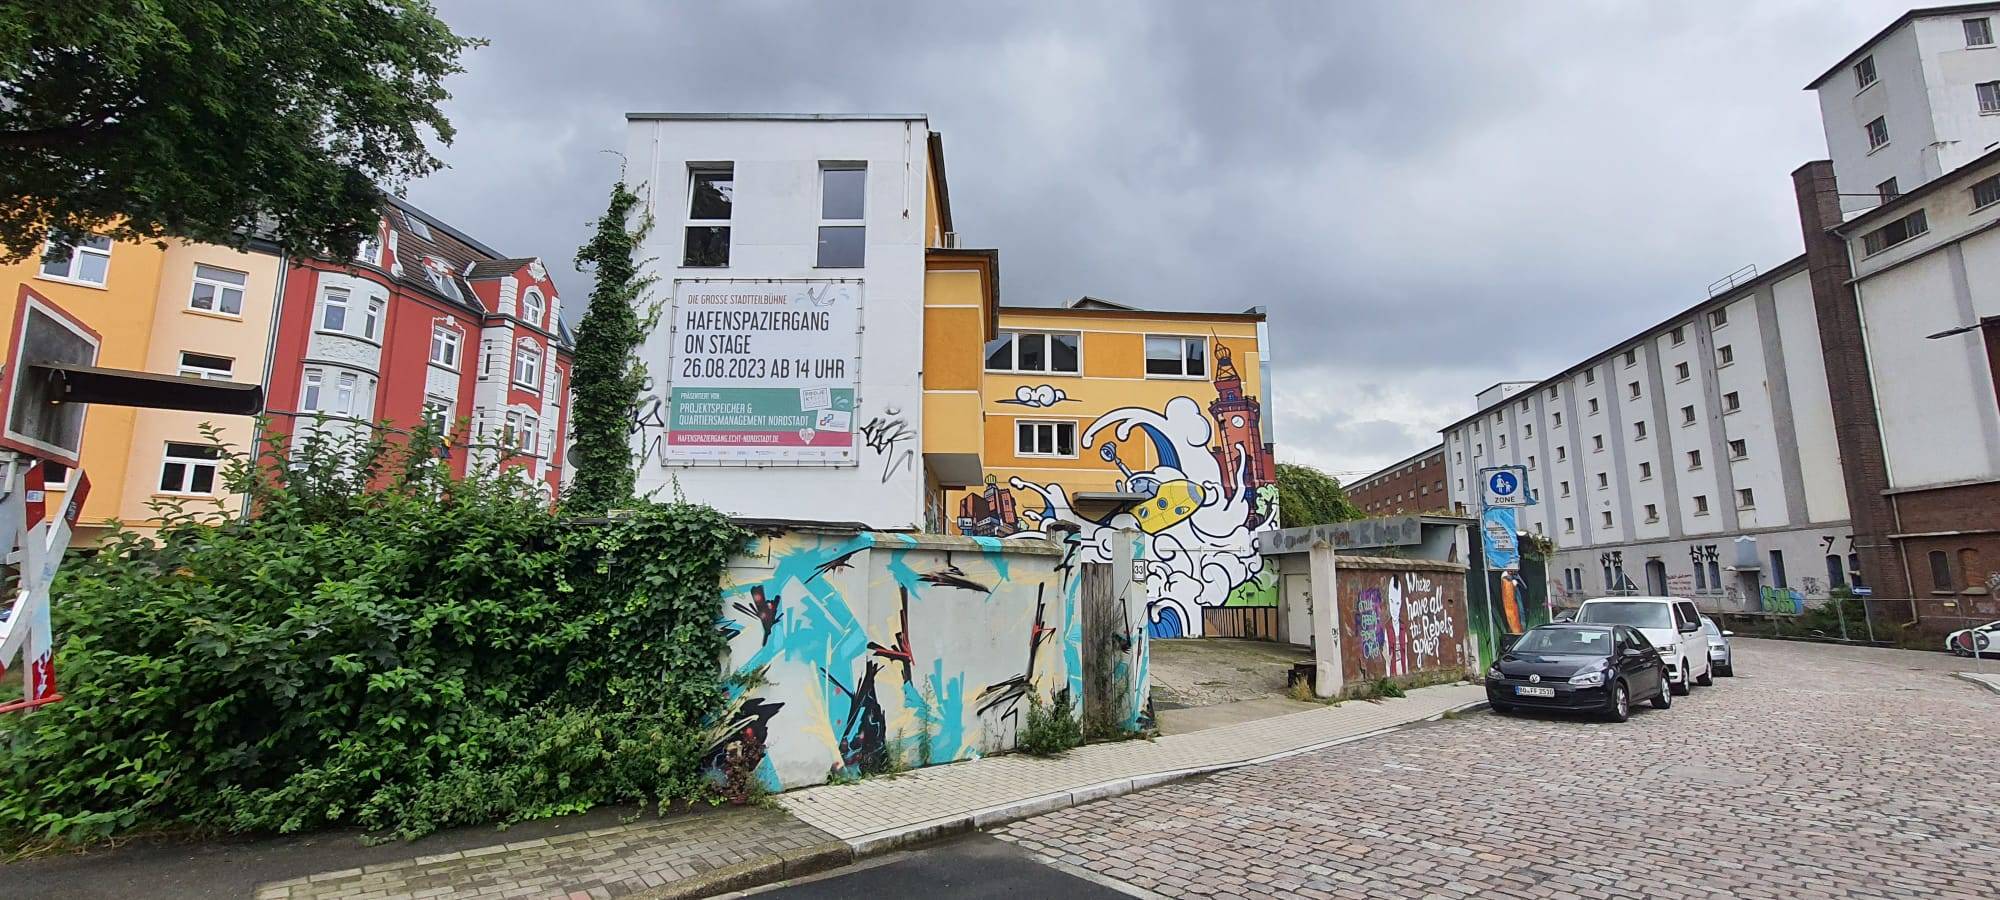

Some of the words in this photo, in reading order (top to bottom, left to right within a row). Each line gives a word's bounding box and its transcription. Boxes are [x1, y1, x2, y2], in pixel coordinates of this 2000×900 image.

[687, 294, 699, 305] DIE
[700, 294, 728, 305] GROSSE
[730, 292, 788, 305] STADTTEILBÜHNE
[686, 311, 830, 331] HAFENSPAZIERGANG
[685, 334, 704, 354] ON
[708, 334, 752, 354] STAGE
[682, 358, 766, 378] 26.08.2023
[770, 359, 790, 379] AB
[795, 359, 810, 379] 14
[815, 359, 845, 379] UHR
[680, 402, 745, 414] PROJEKTSPEICHER
[746, 402, 752, 414] &
[679, 414, 766, 426] QUARTIERSMANAGEMENT
[768, 416, 808, 426] NORDSTADT
[1494, 496, 1516, 504] ZONE
[1134, 566, 1144, 574] 33
[1406, 572, 1431, 594] Where
[1406, 597, 1428, 620] have
[1430, 585, 1444, 614] all
[1422, 609, 1453, 642] Rebels
[1412, 636, 1440, 669] gone?
